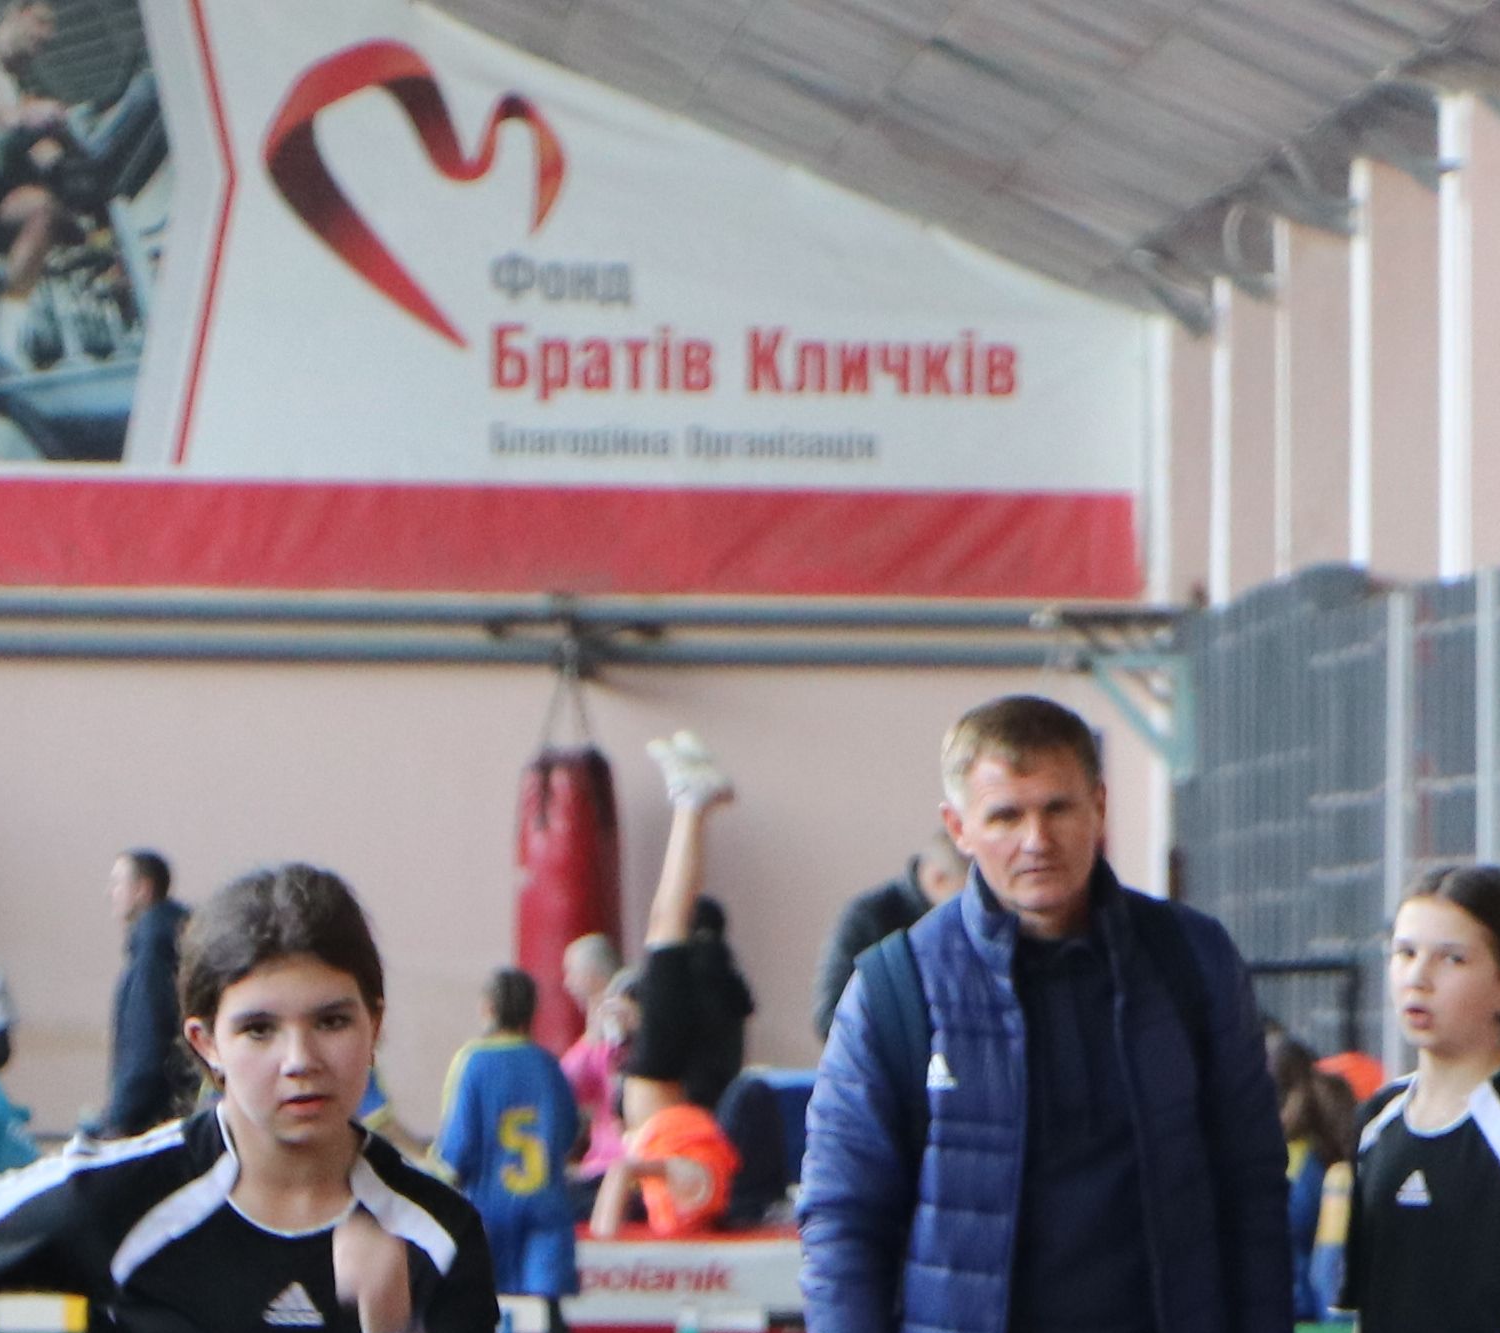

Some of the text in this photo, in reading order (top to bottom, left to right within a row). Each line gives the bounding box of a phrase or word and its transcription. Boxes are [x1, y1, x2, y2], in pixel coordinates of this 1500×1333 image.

[490, 252, 632, 306] Фонд
[490, 323, 1017, 403] Братів Кличків
[498, 1106, 548, 1195] 5
